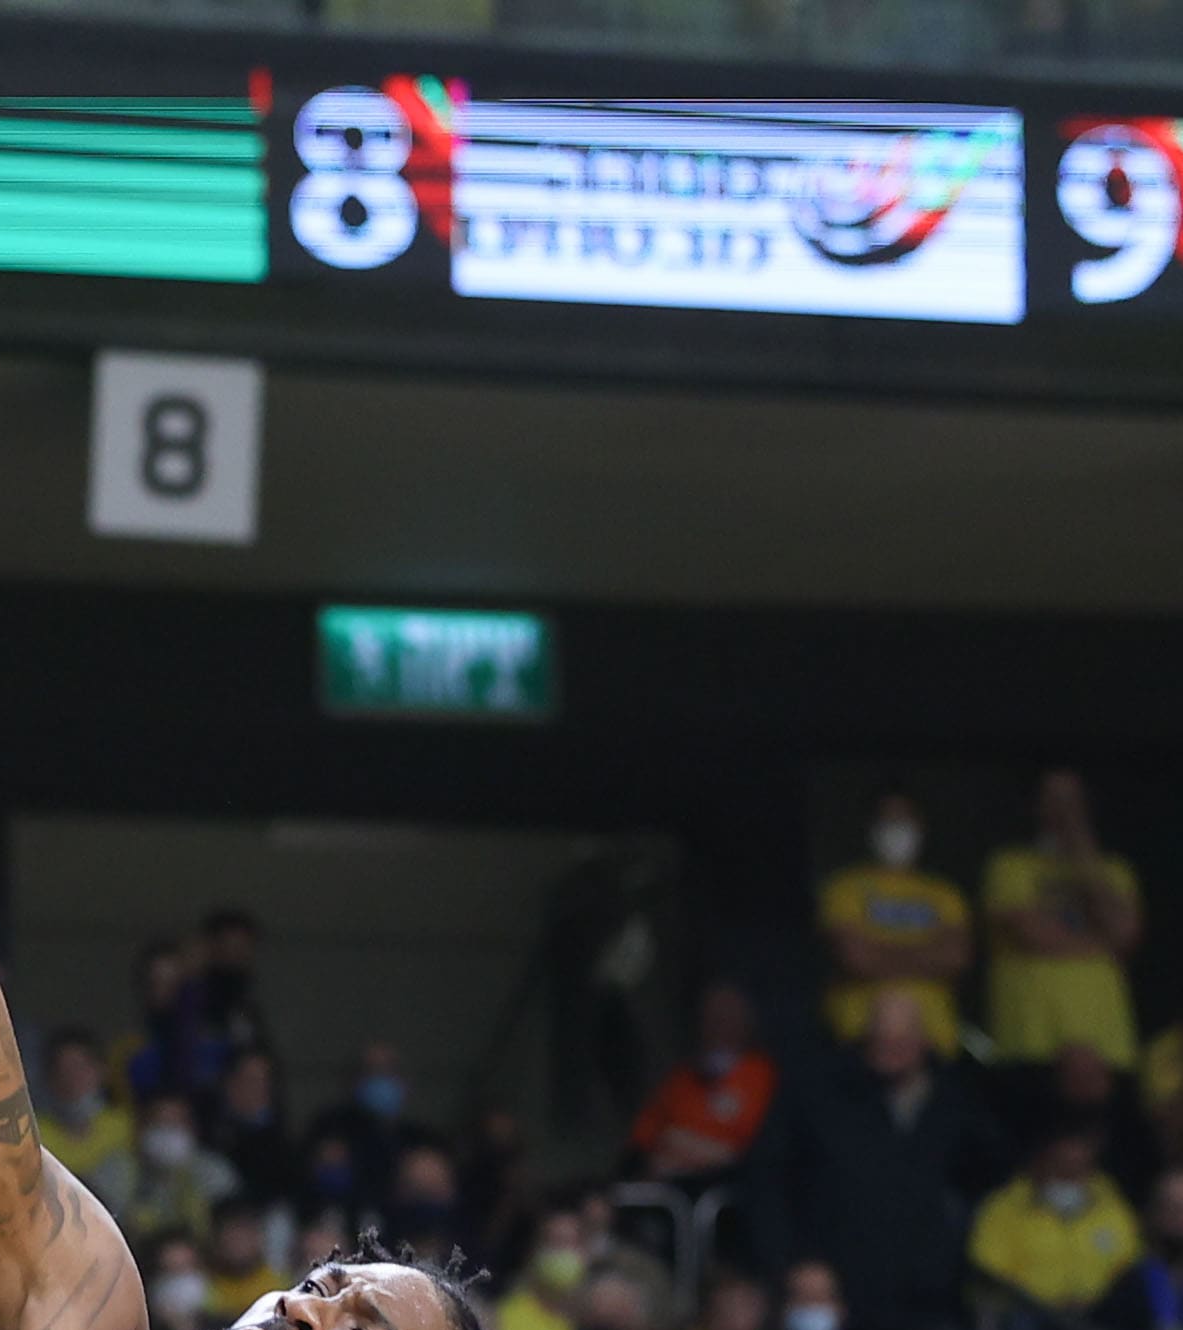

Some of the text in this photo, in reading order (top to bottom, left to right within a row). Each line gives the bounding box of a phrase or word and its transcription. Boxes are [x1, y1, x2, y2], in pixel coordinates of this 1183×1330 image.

[290, 85, 418, 269] 8
[1056, 123, 1181, 304] 9
[141, 392, 210, 502] 8
